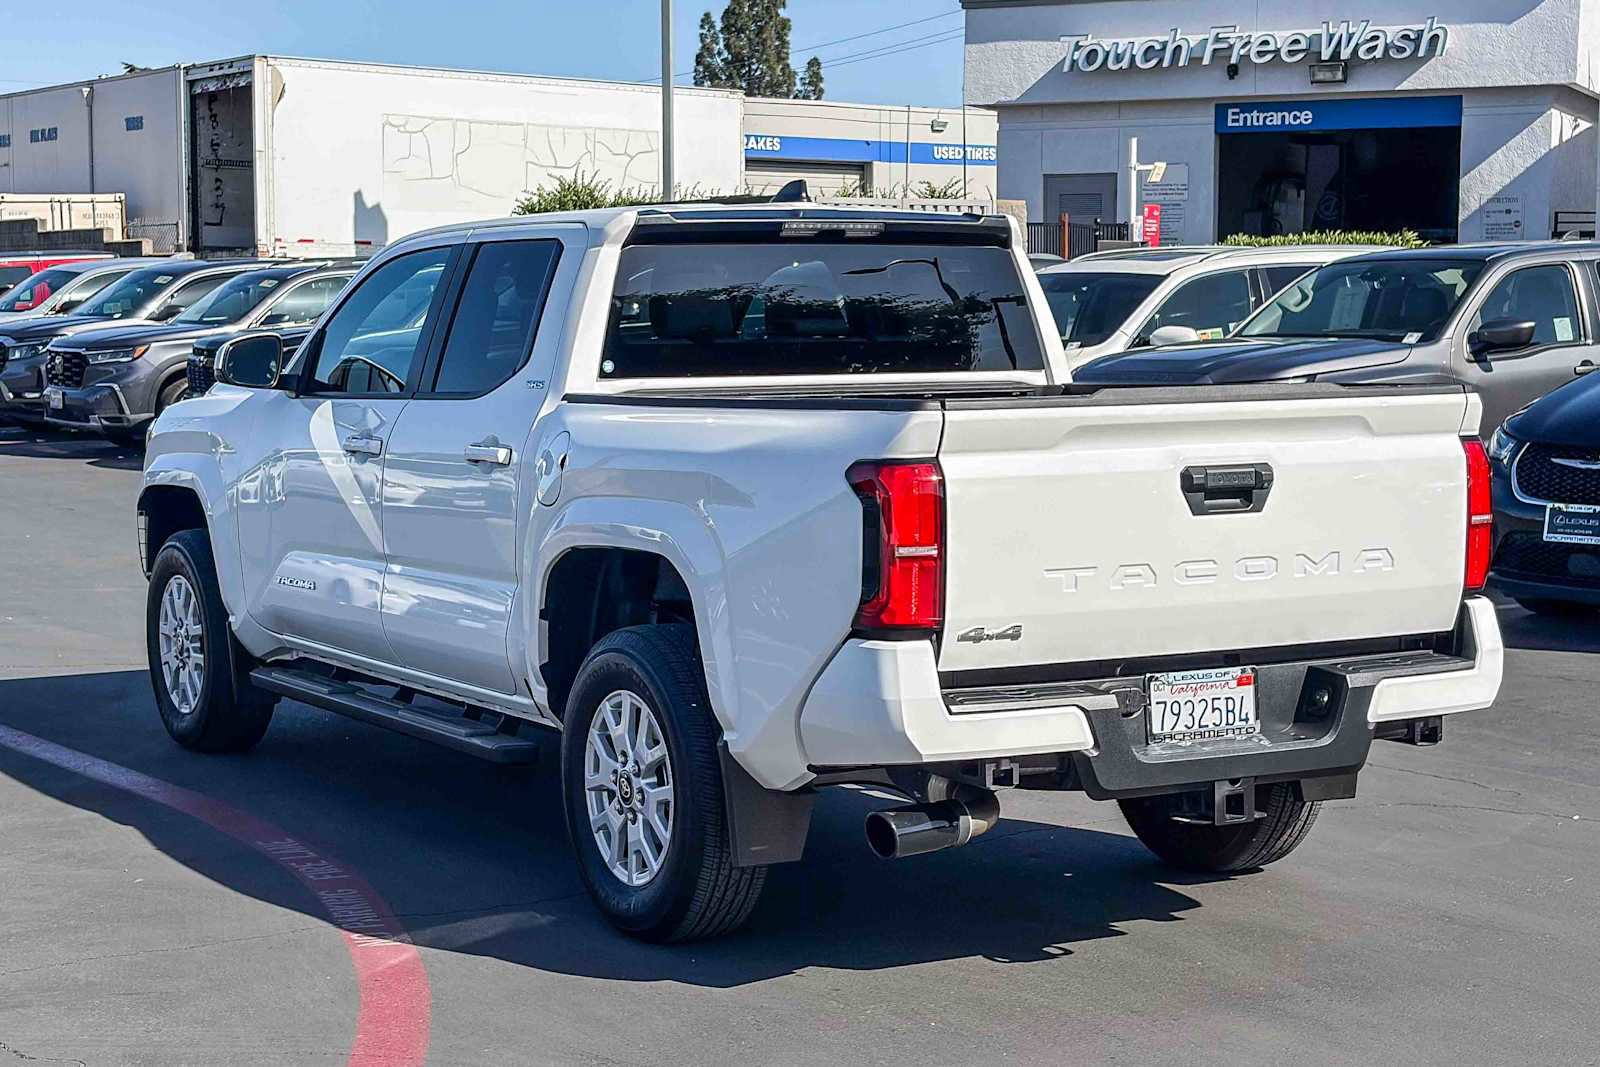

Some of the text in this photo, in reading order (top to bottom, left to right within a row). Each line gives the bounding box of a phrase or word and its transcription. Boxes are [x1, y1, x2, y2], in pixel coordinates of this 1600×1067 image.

[1059, 16, 1449, 73] Touch Free Wash
[1226, 107, 1313, 128] Entrance
[933, 146, 996, 161] USED TIRES
[1566, 517, 1599, 526] LEXUS
[1042, 547, 1395, 593] TACOMA
[275, 575, 316, 591] TACOMA
[956, 624, 1022, 644] 4x4
[1173, 673, 1213, 682] LEXUS
[1170, 681, 1237, 698] California
[1155, 695, 1250, 732] 79325B4
[1151, 725, 1257, 744] SACRAMENTO
